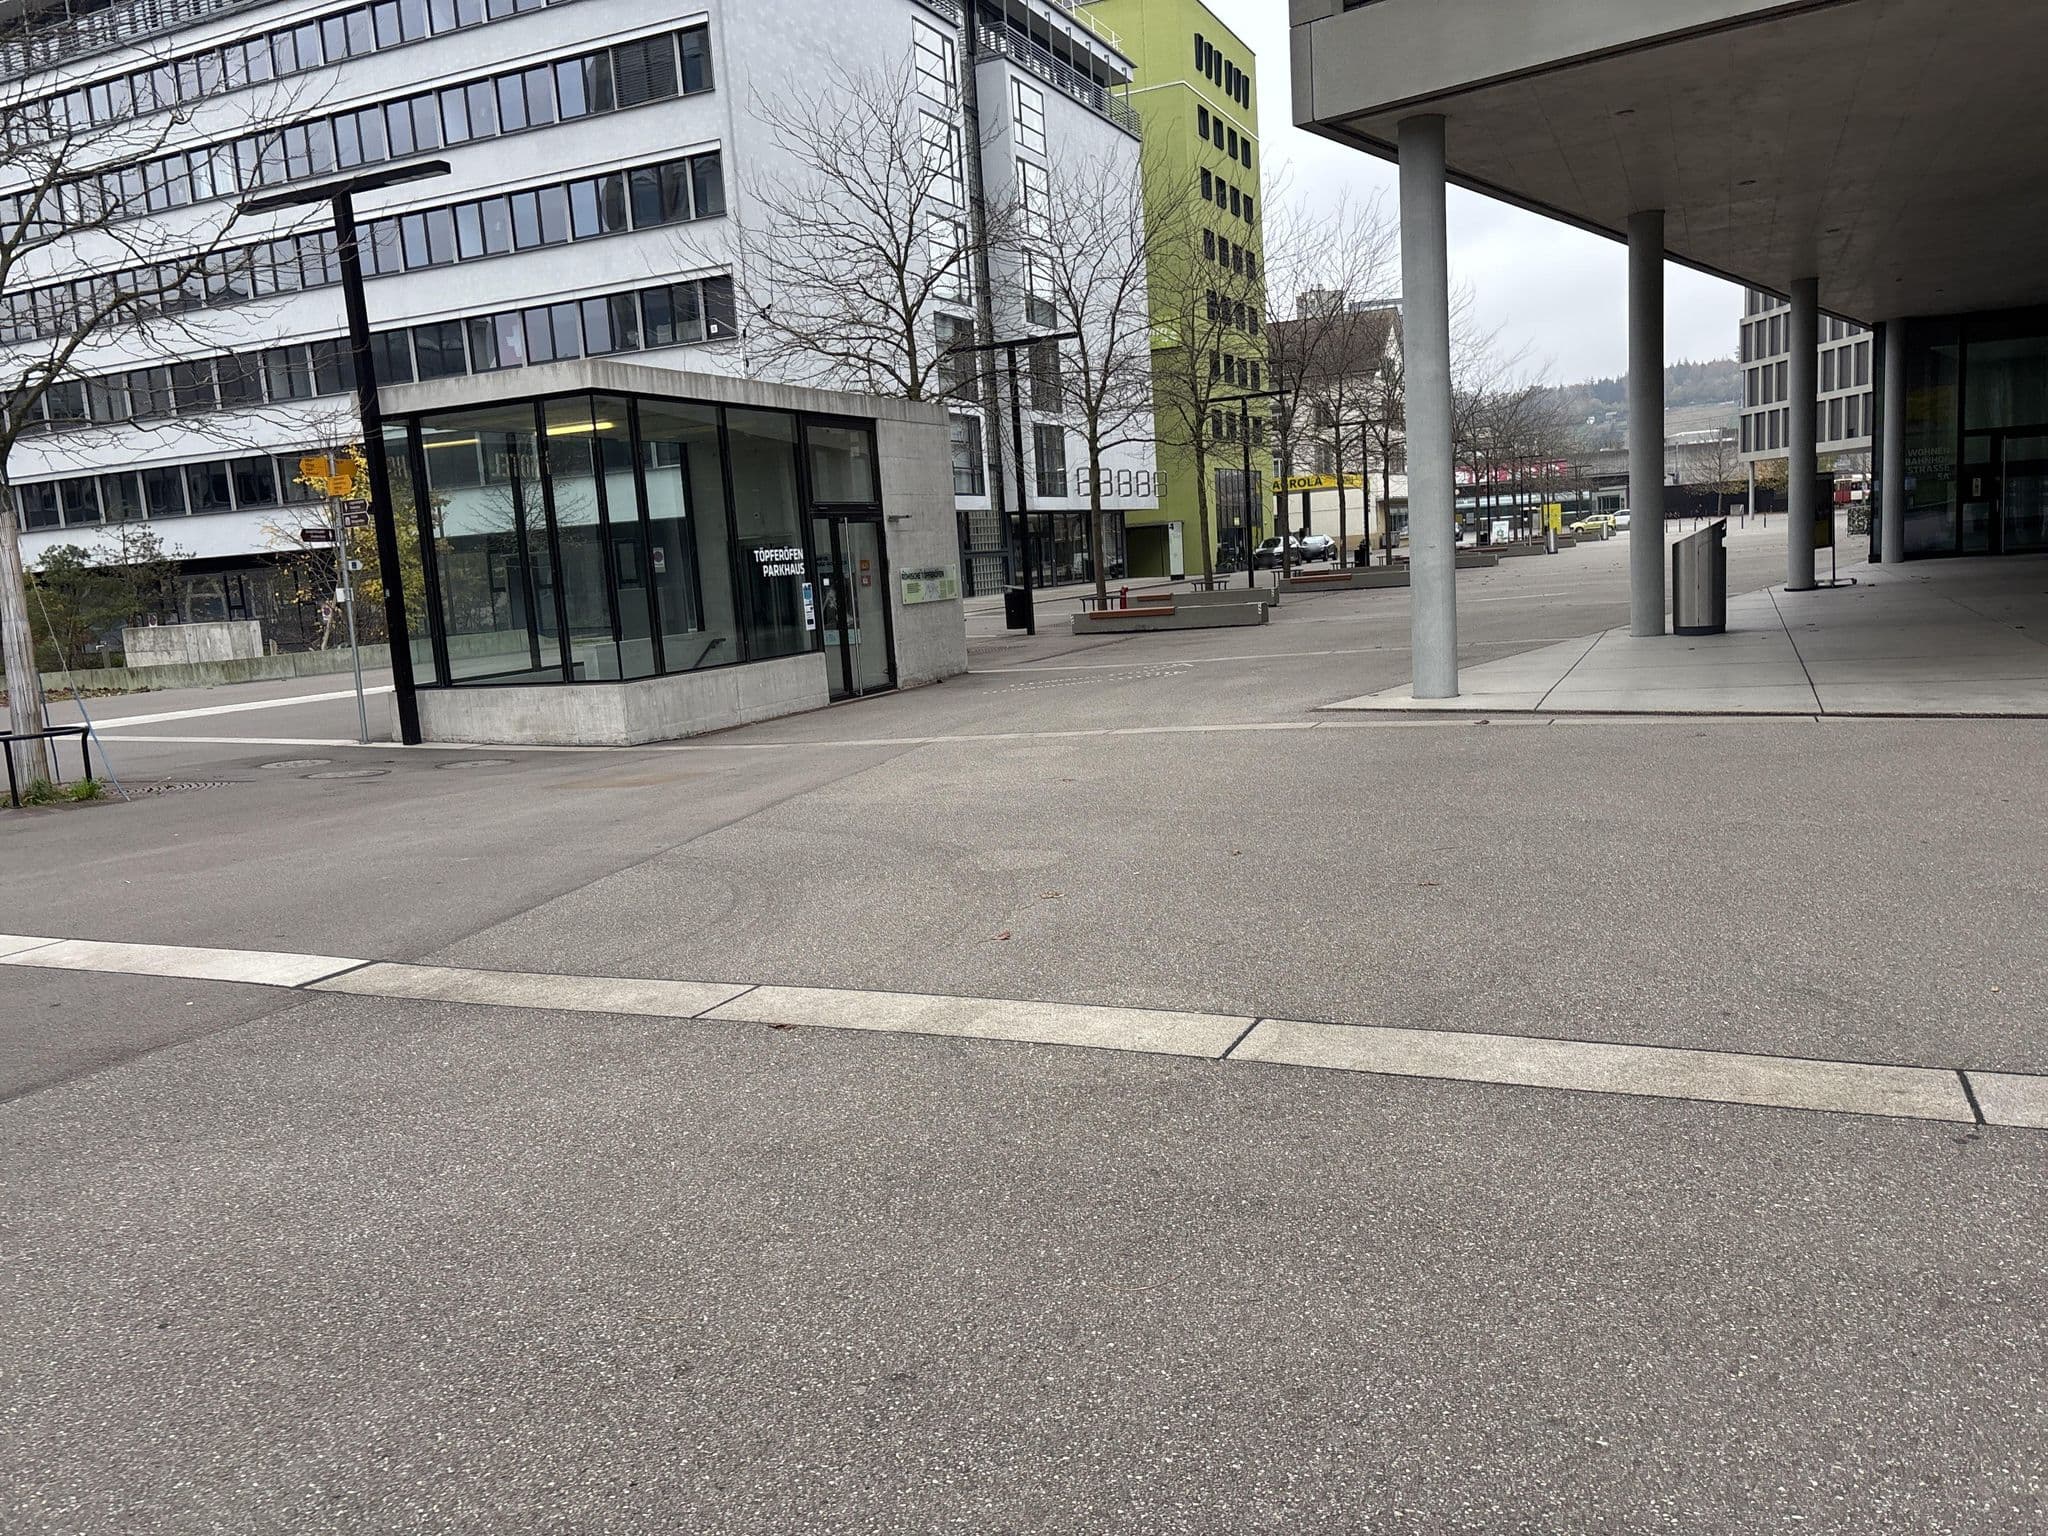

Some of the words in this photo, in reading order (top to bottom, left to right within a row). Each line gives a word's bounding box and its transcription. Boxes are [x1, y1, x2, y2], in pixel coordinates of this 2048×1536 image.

[1272, 477, 1323, 490] AROLA
[753, 545, 804, 563] TÖPFERÖFEN
[762, 562, 806, 577] PARKHAUS
